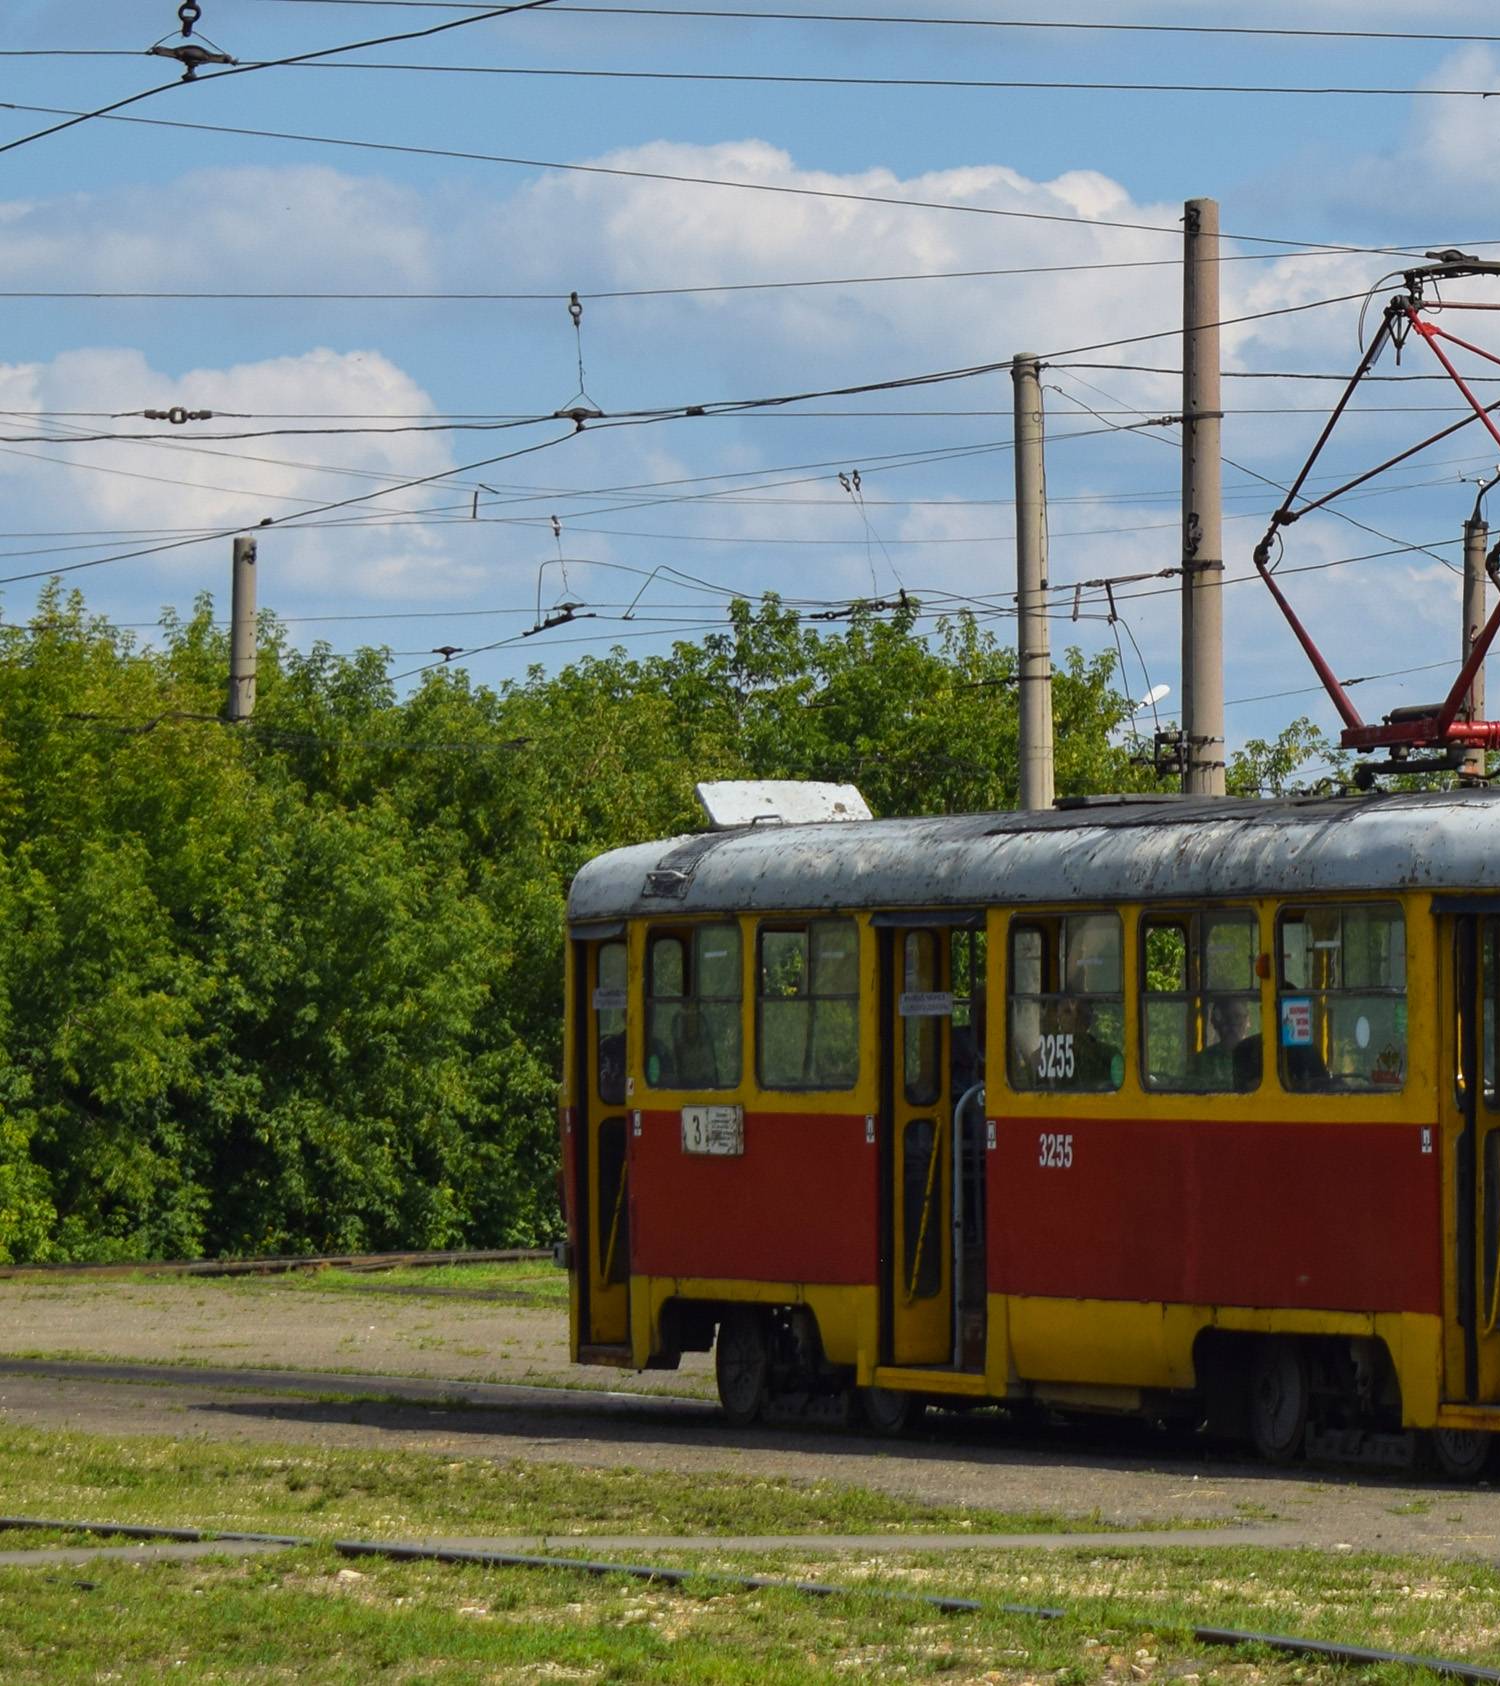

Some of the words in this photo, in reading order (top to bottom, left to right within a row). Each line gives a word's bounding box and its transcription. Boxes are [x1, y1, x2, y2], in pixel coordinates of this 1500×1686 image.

[1038, 1034, 1075, 1078] 3255
[692, 1115, 702, 1145] 3
[1039, 1133, 1073, 1168] 3255
